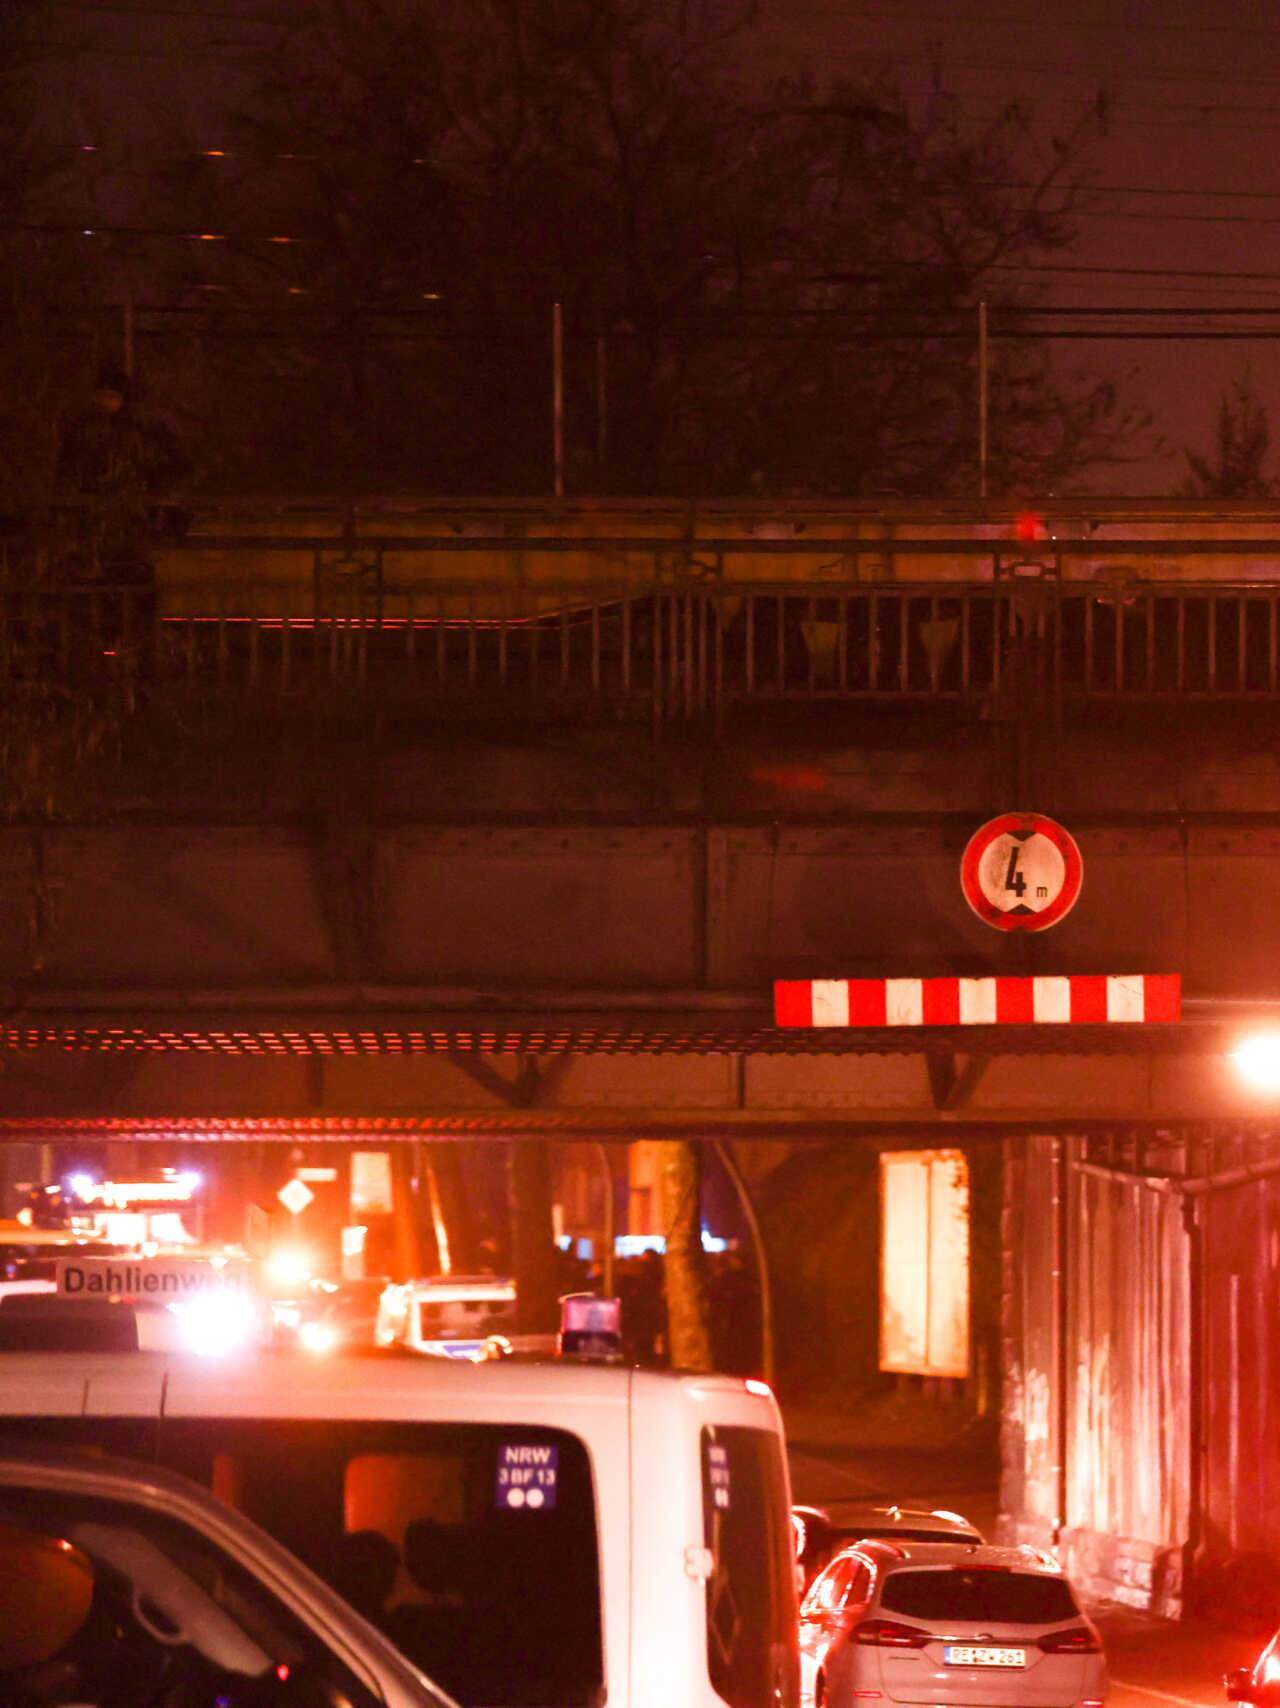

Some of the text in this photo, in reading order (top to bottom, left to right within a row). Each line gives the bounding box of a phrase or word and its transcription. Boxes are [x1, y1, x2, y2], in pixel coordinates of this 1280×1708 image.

[1005, 846, 1048, 898] 4 m
[505, 1447, 550, 1463] NRW
